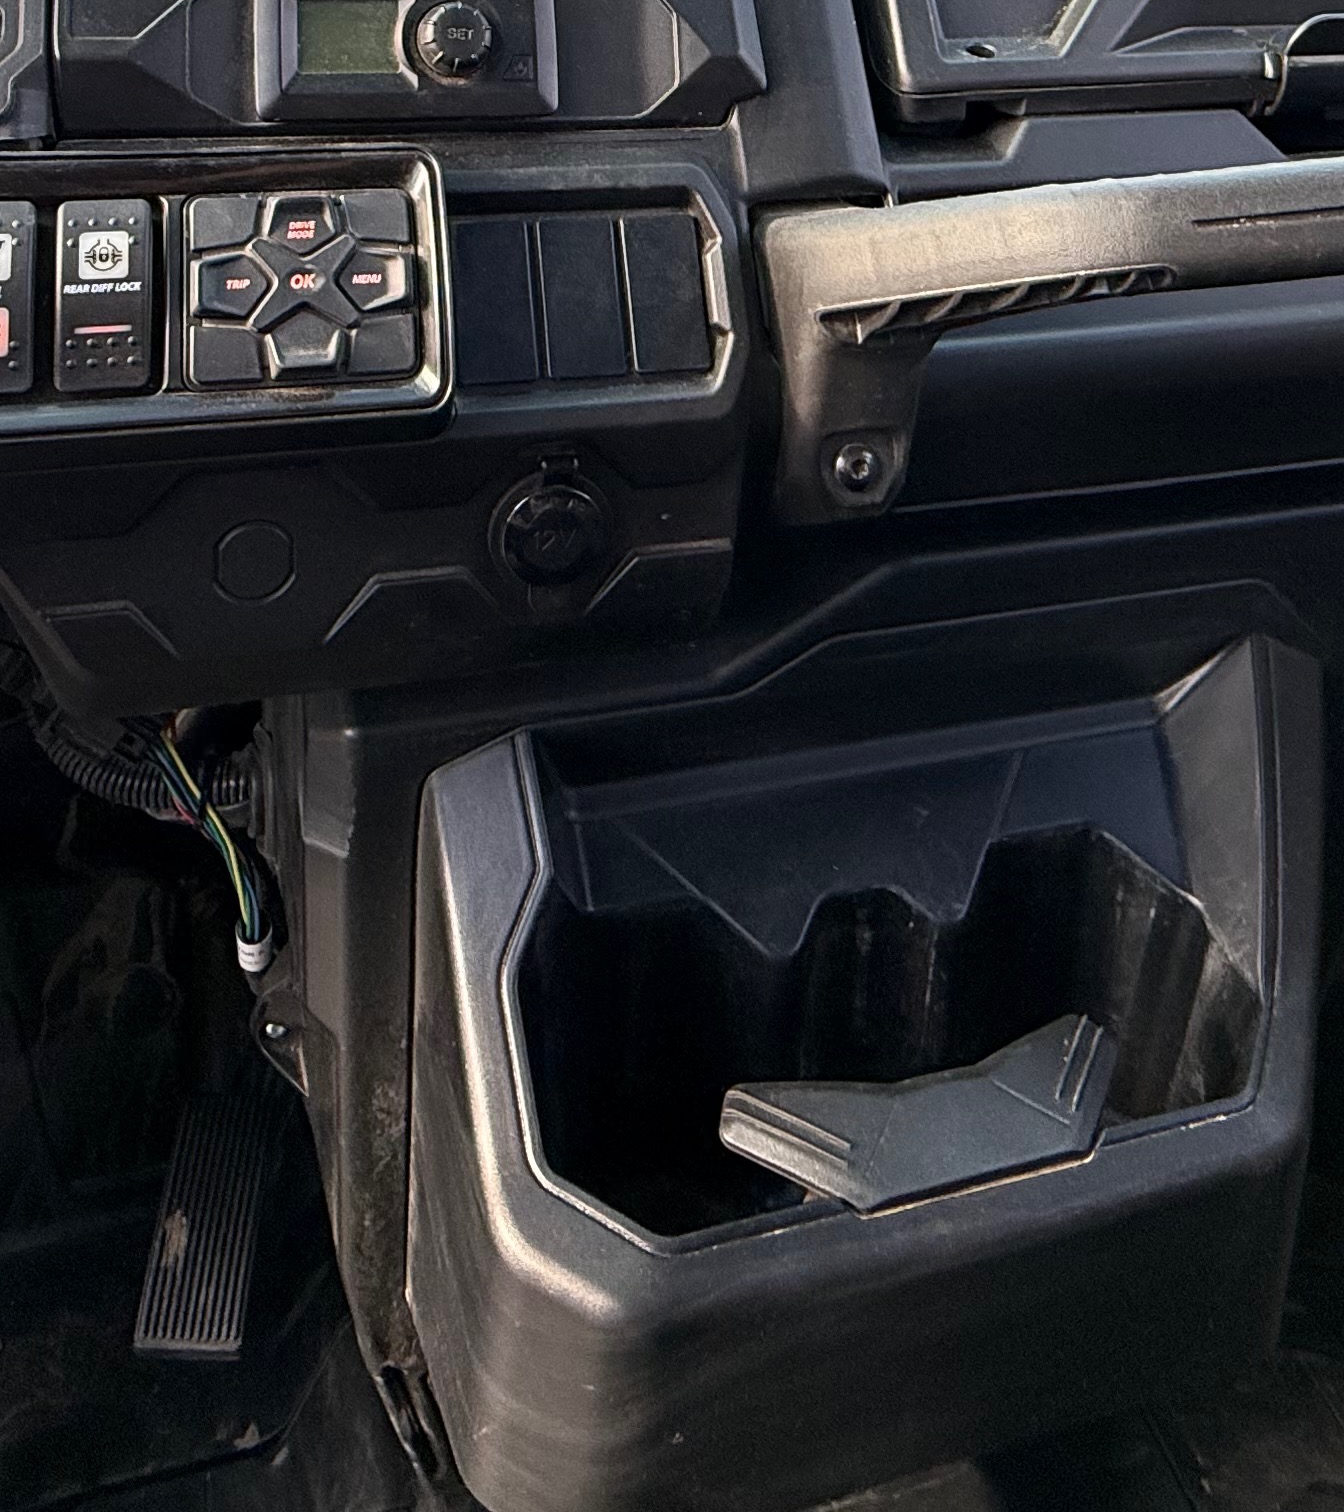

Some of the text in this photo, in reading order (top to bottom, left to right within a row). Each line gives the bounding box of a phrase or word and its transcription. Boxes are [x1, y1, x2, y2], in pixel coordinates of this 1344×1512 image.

[446, 26, 475, 42] SET
[225, 278, 251, 290] TRIP
[289, 273, 317, 290] OK
[351, 273, 383, 285] MENU
[63, 281, 143, 295] REAR DIFF LOCK
